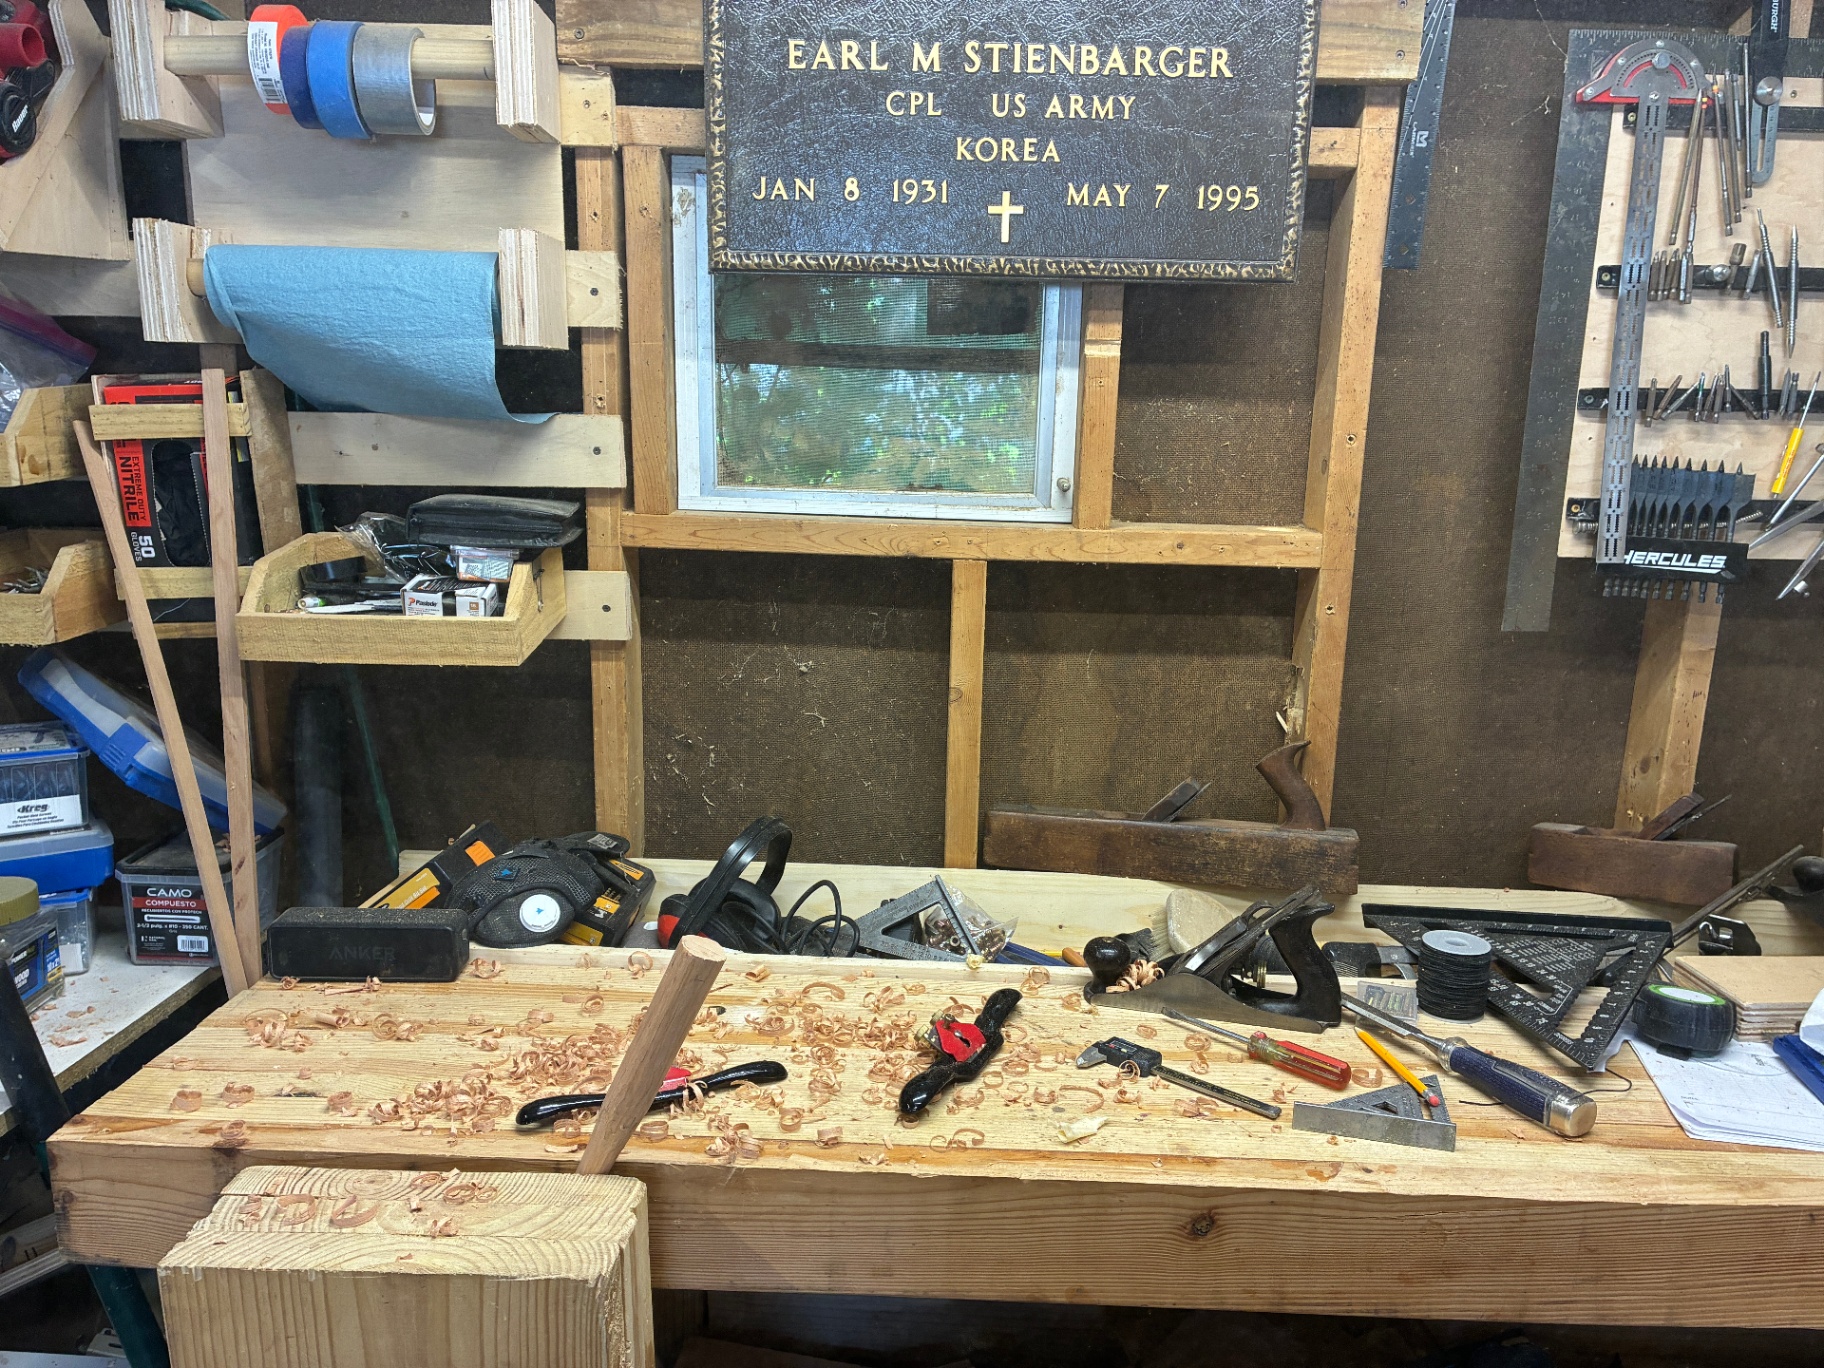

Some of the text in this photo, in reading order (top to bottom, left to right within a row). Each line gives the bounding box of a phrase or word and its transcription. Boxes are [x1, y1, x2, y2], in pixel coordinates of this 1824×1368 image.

[787, 41, 1234, 79] EARL M STIENBARGER
[886, 92, 1136, 120] CPL US ARMY
[956, 137, 1061, 163] KOREA
[752, 177, 949, 205] JAN 8 1931
[1066, 182, 1261, 212] MAY 7 1995
[119, 456, 140, 522] NITRILE
[132, 456, 147, 521] EXTREME DUTY
[130, 531, 143, 562] GLOVES
[138, 535, 156, 559] 50
[1624, 550, 1727, 568] HERCULES
[20, 804, 48, 813] Kreg
[145, 899, 197, 908] COMPUESTO
[146, 887, 192, 898] CAMO
[328, 945, 397, 962] ANKER
